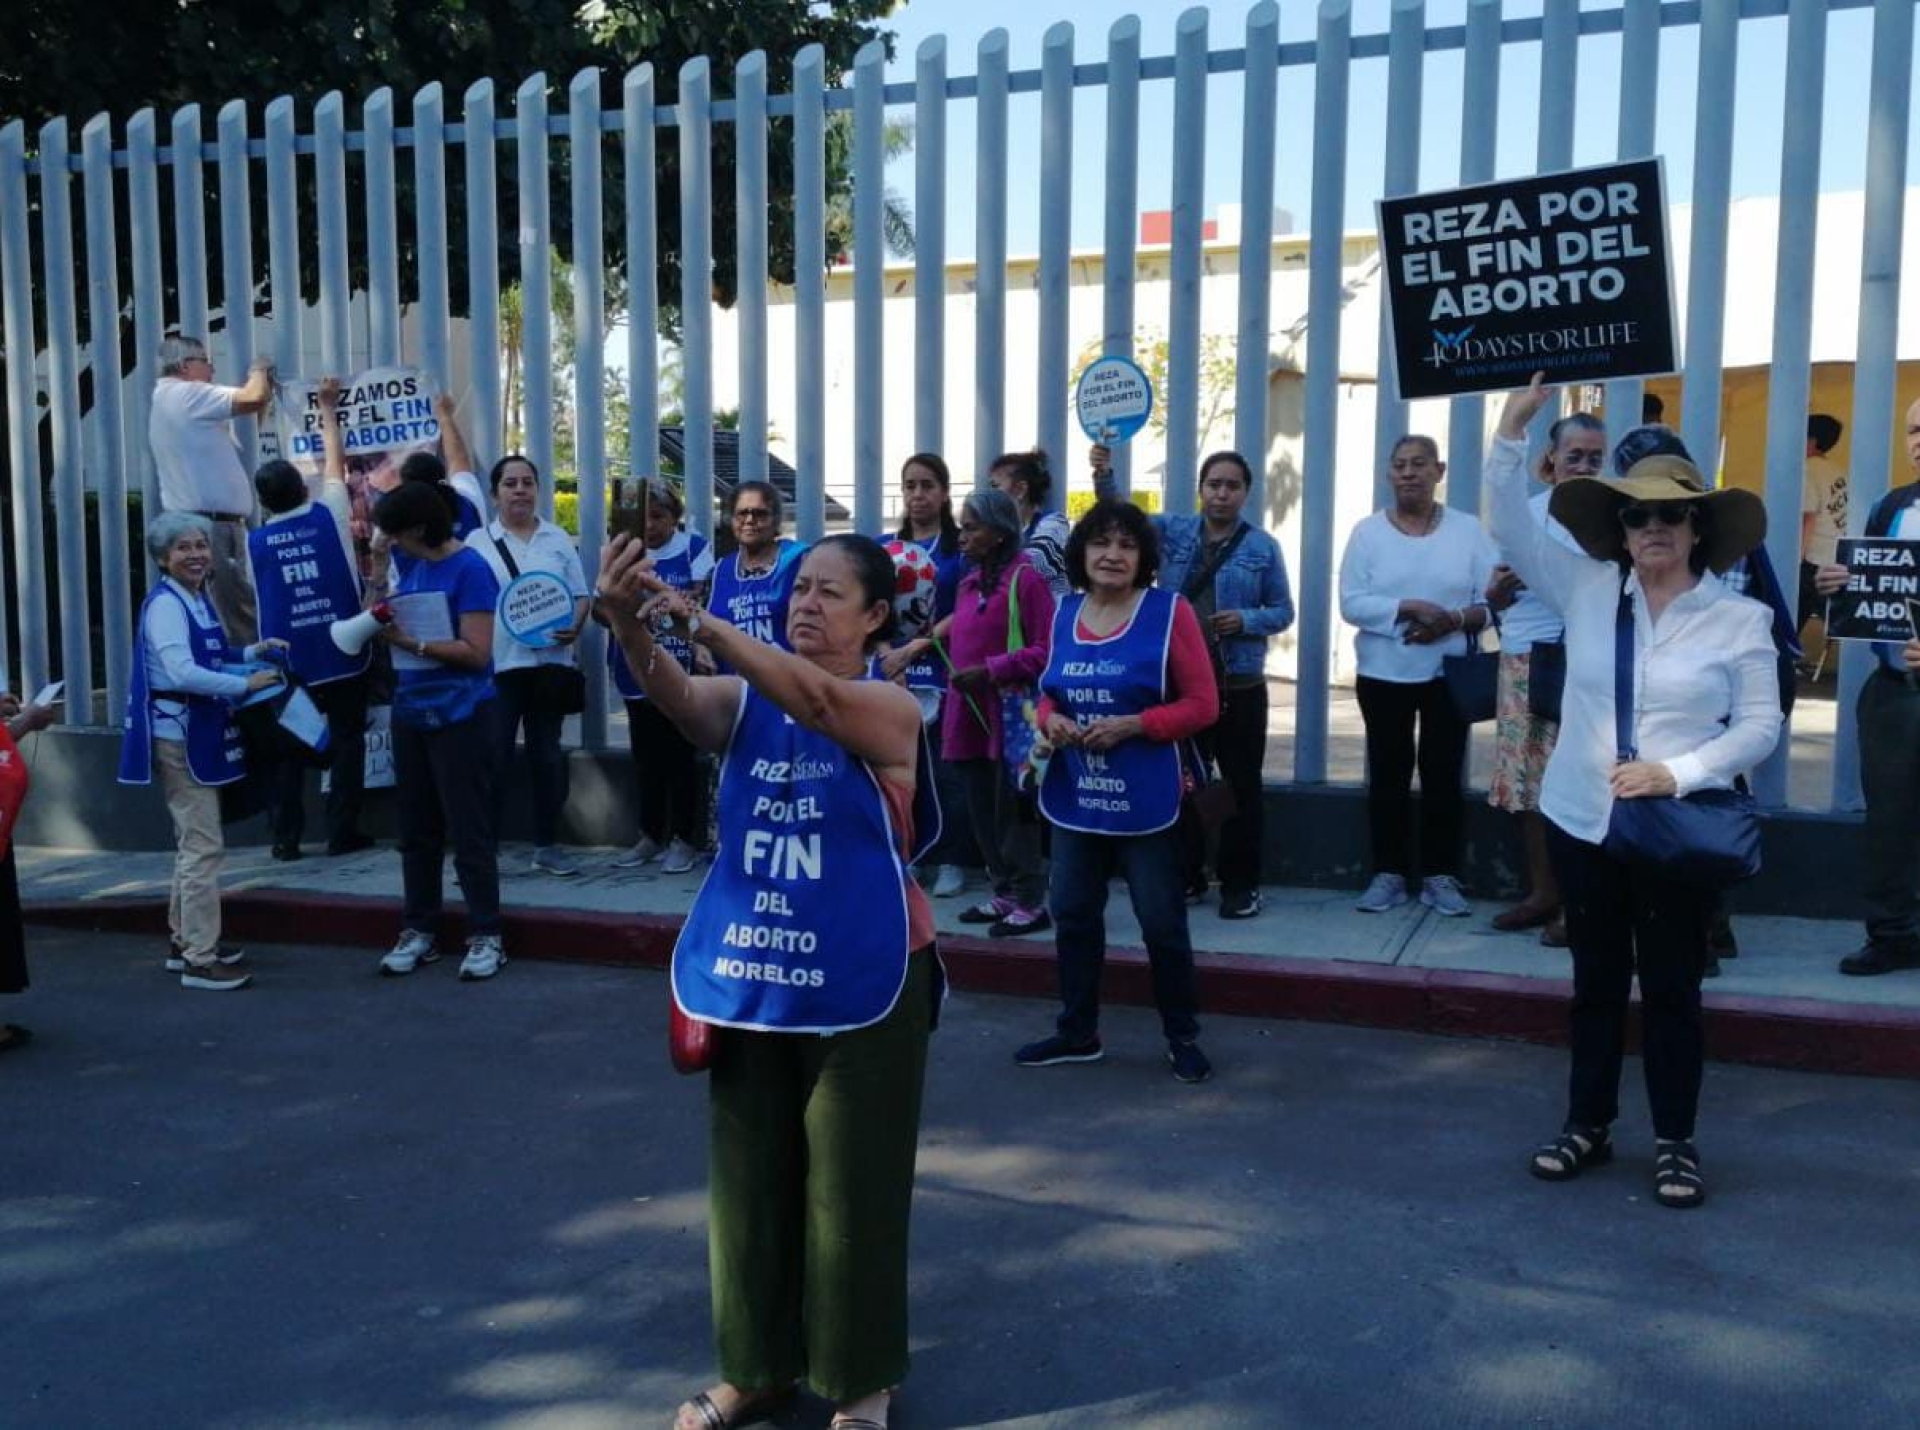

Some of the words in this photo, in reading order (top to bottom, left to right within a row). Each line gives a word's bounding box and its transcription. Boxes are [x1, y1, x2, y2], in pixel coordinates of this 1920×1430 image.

[1403, 199, 1527, 246] REZA
[1539, 182, 1639, 227] POR
[1402, 250, 1456, 286] EL
[1467, 236, 1543, 277] FIN
[1556, 223, 1650, 265] DEL
[1429, 266, 1625, 320] ABORTO
[1094, 370, 1119, 381] REZA
[308, 378, 417, 410] RZAMOS
[1084, 386, 1102, 395] POR
[1118, 381, 1135, 389] FIN
[1101, 391, 1142, 404] ABORTO
[305, 411, 349, 432] PR
[359, 405, 385, 424] EL
[392, 397, 431, 420] FIN
[293, 433, 324, 453] DE
[345, 419, 438, 448] ABORTO
[278, 548, 300, 559] POR
[302, 545, 316, 555] EL
[1853, 548, 1915, 567] REZA
[283, 561, 318, 584] FIN
[1847, 575, 1872, 591] EL
[1879, 577, 1917, 593] FIN
[757, 604, 772, 616] EL
[1855, 601, 1909, 620] ABO
[1068, 688, 1095, 702] POR
[1097, 689, 1114, 702] EL
[751, 758, 790, 782] REZ
[797, 796, 824, 821] EL
[743, 830, 821, 880] FIN
[753, 891, 793, 916] DEL
[723, 922, 817, 953] ABORTO
[712, 957, 826, 987] MORELOS
